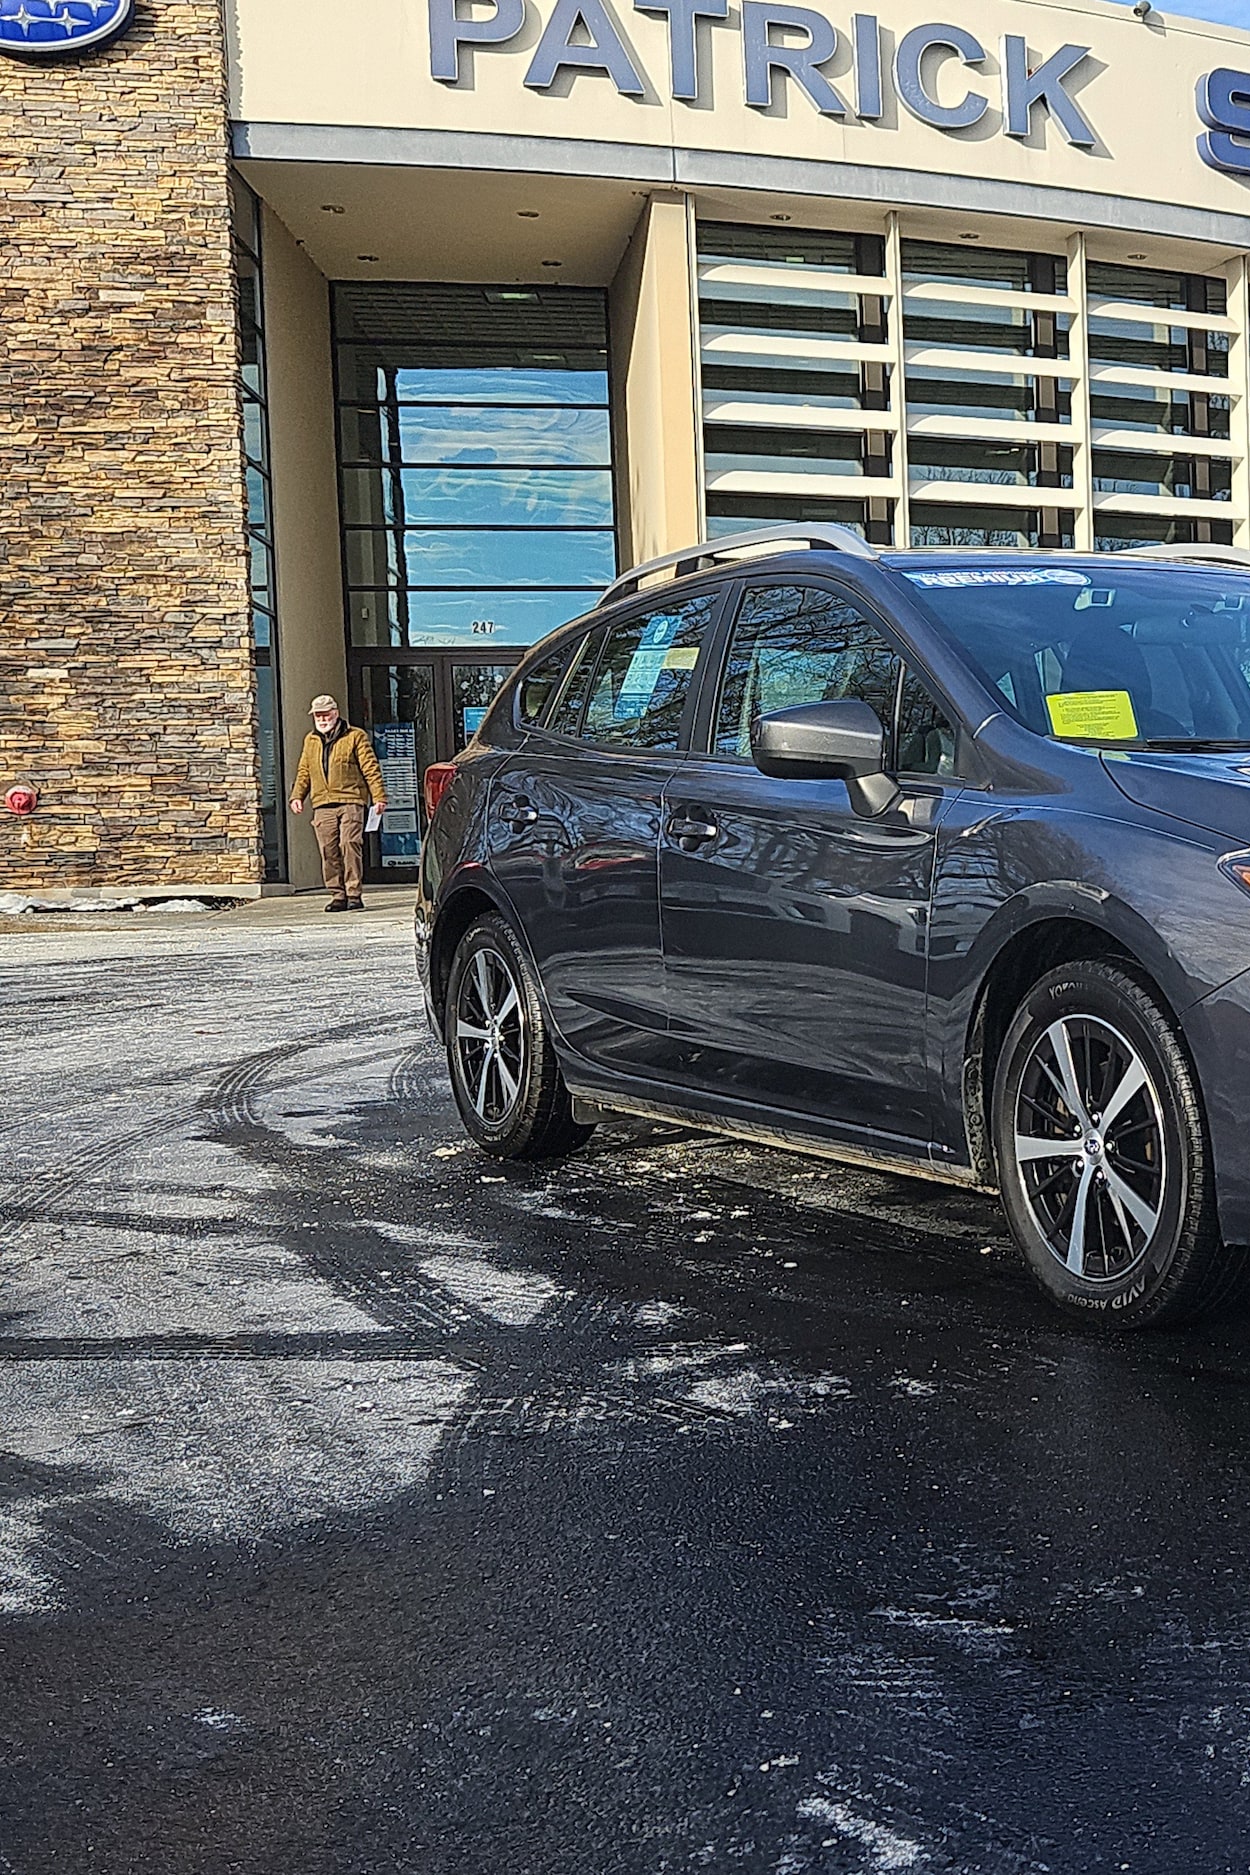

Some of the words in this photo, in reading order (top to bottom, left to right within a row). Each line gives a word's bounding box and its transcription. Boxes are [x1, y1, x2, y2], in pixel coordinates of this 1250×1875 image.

[429, 0, 1096, 146] PATRICK
[472, 620, 494, 634] 247
[1112, 1275, 1145, 1309] AVID
